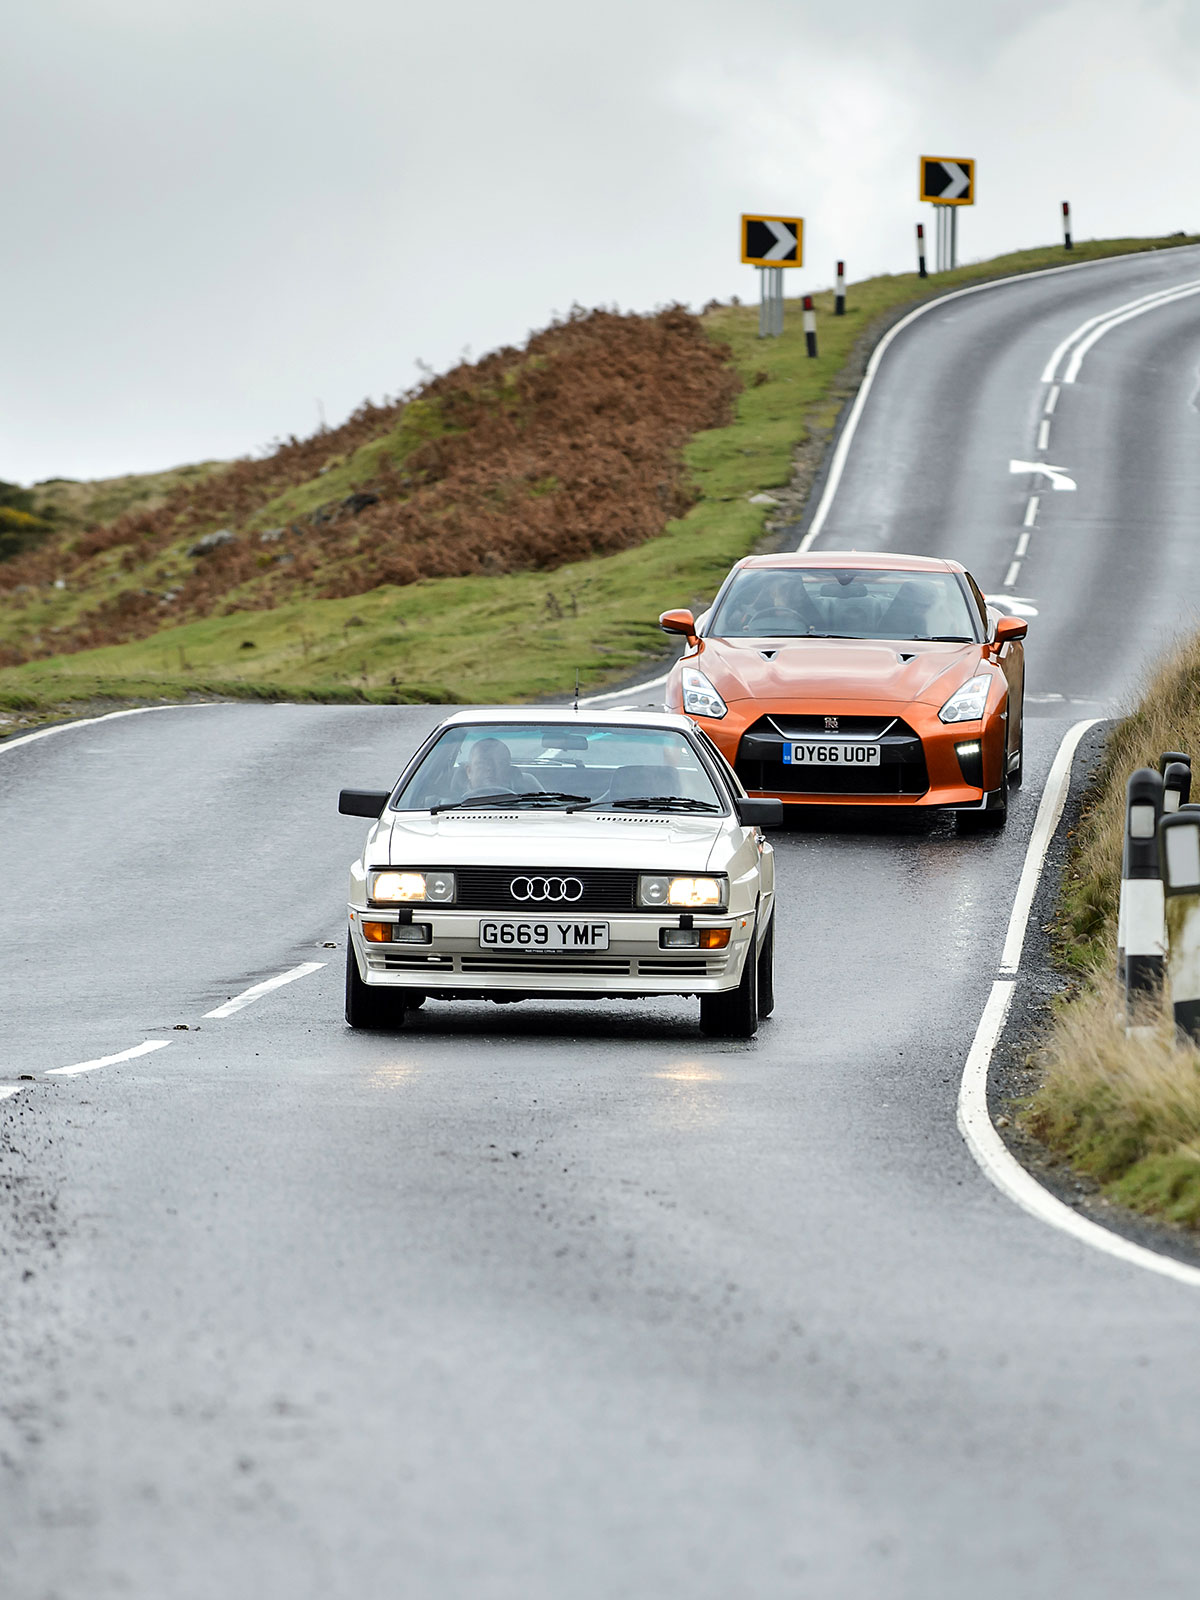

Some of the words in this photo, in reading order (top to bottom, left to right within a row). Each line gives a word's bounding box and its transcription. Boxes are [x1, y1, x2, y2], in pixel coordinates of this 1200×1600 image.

[794, 745, 839, 762] OY66
[844, 746, 877, 763] UOP
[482, 923, 549, 945] G669
[557, 924, 606, 946] YMF
